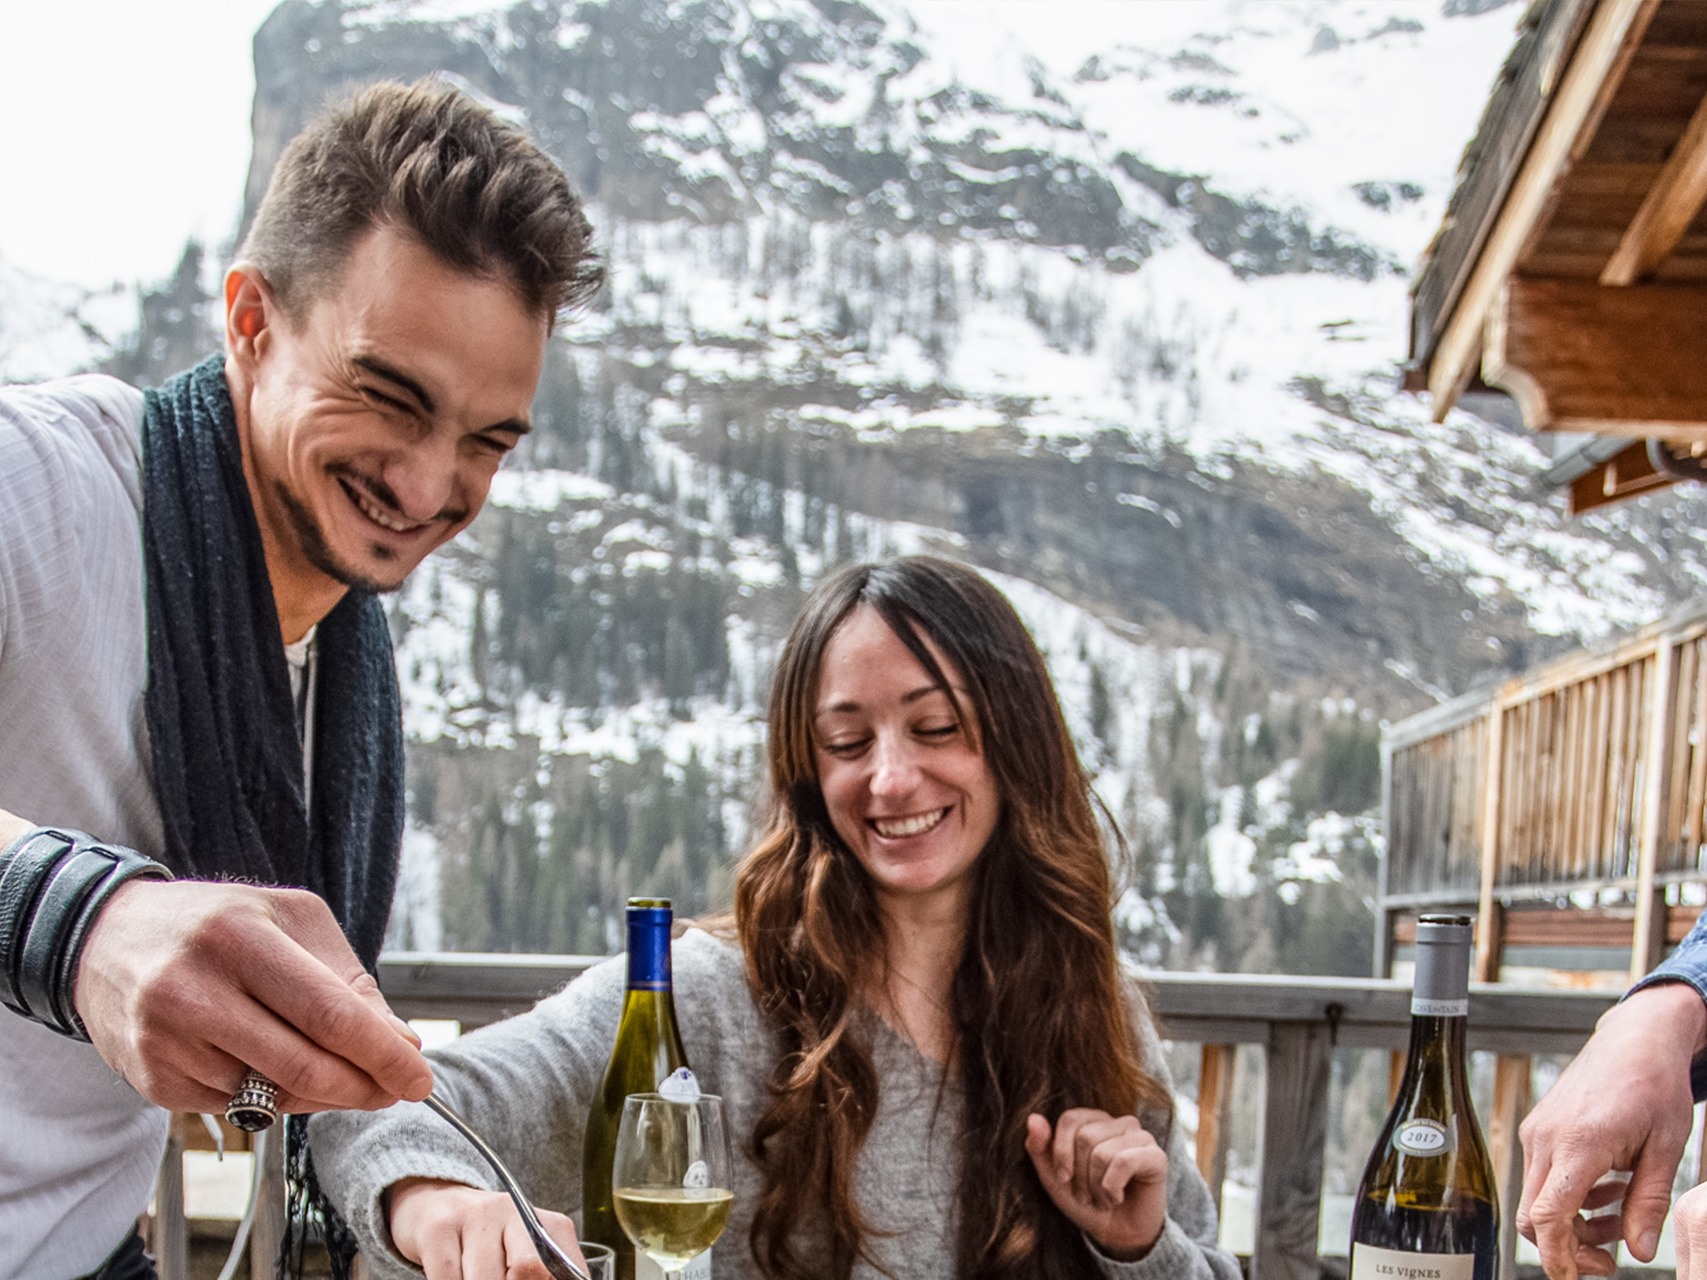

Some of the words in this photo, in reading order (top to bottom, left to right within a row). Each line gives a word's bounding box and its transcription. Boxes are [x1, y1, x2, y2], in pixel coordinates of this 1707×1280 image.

[1407, 1132, 1438, 1143] 2017
[1376, 1264, 1394, 1275] LES
[1397, 1266, 1441, 1279] VIGNES
